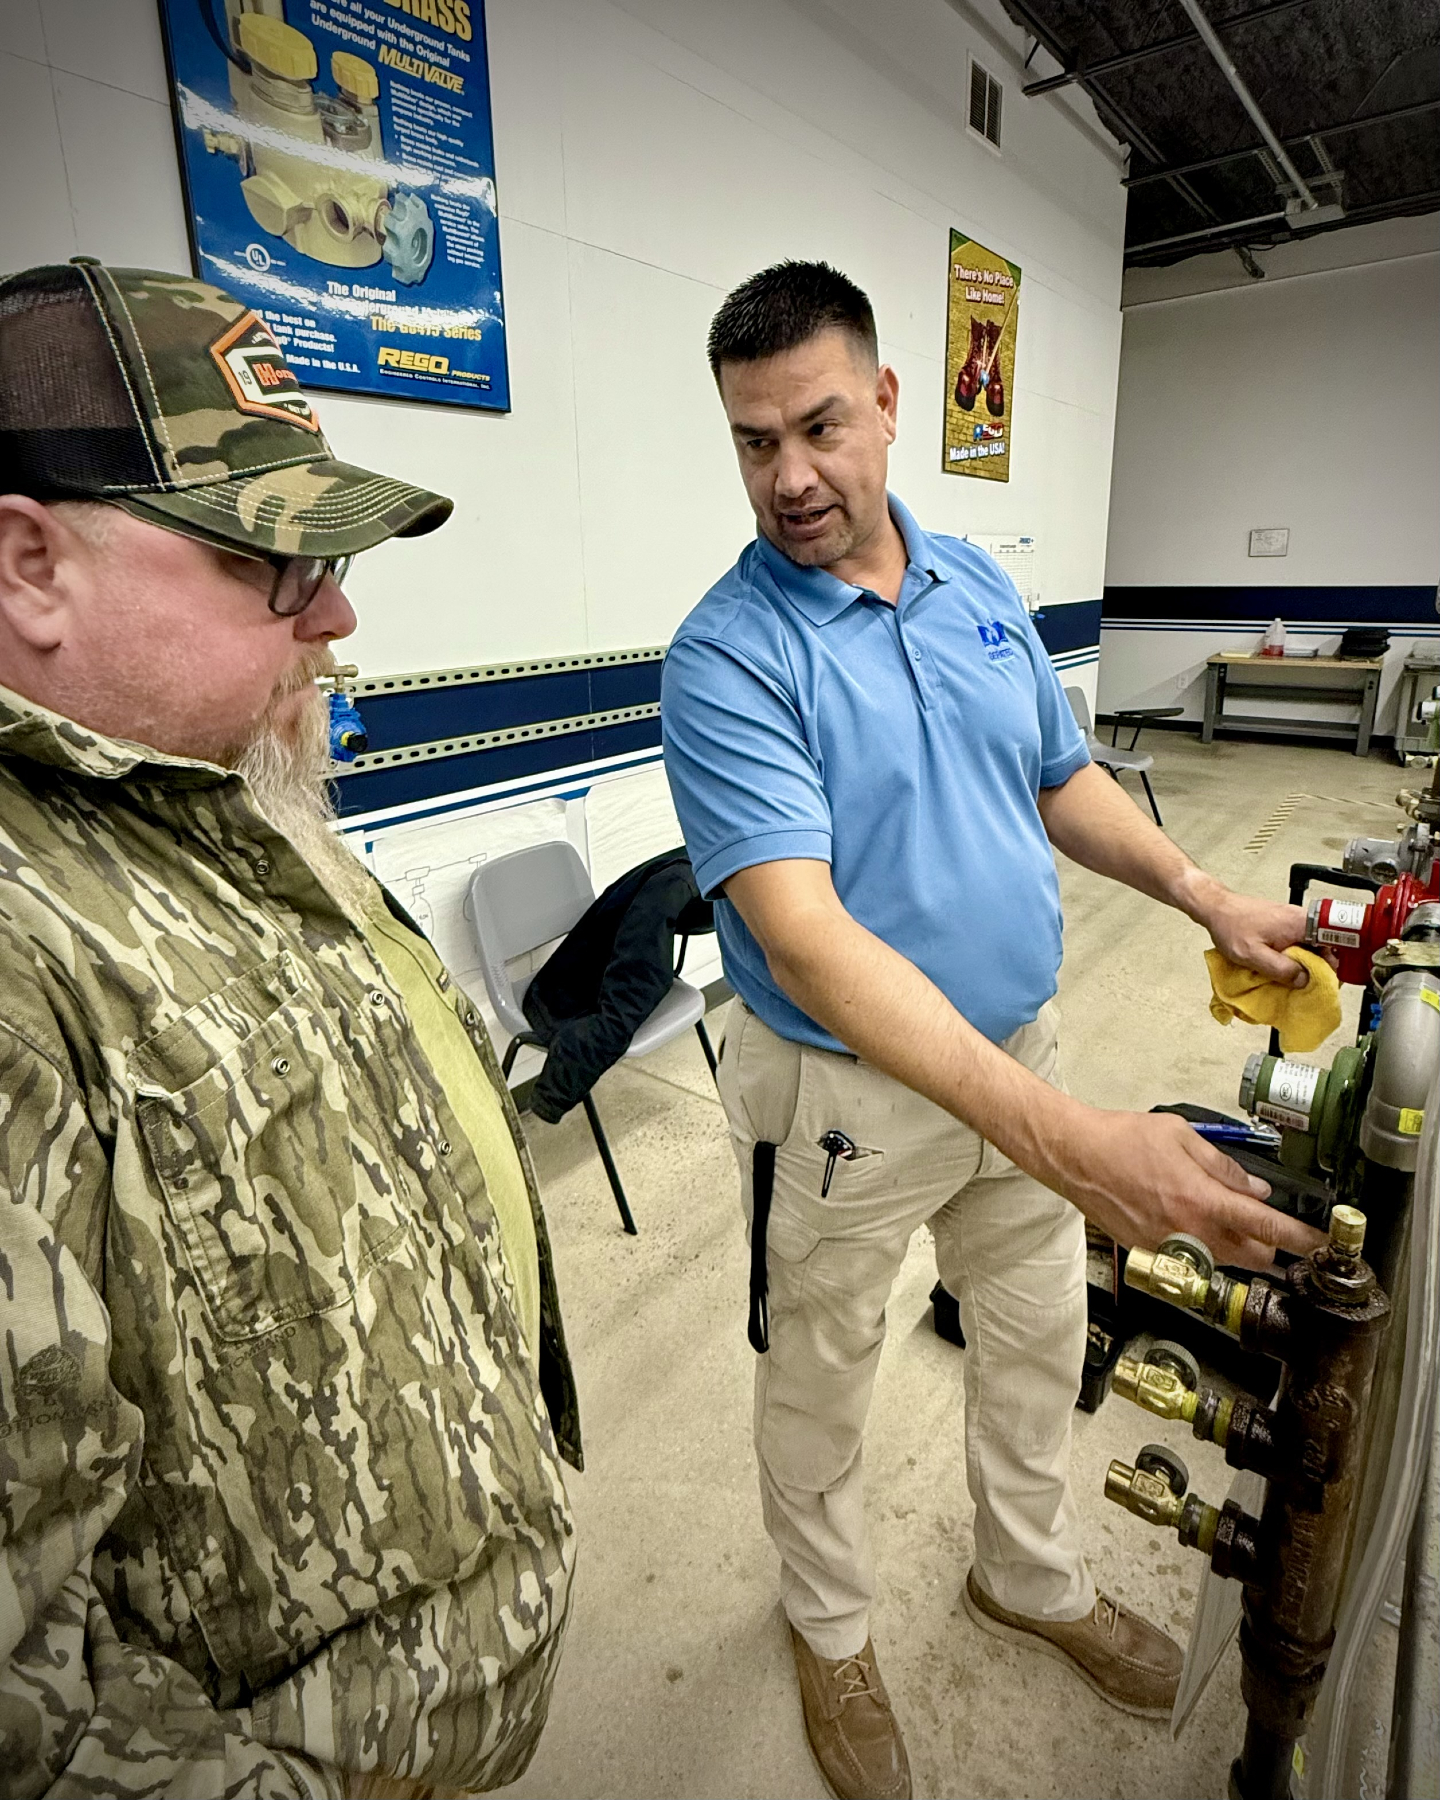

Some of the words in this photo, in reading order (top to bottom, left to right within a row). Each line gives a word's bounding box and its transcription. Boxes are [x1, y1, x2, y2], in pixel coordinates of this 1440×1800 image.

[311, 12, 376, 50] Underground
[383, 0, 472, 41] ASS
[309, 0, 327, 13] are
[329, 8, 375, 35] equipped
[377, 28, 397, 45] with
[399, 37, 414, 52] the
[416, 44, 450, 67] Original
[350, 2, 362, 14] all
[364, 8, 386, 24] your
[387, 16, 445, 51] Underground
[447, 42, 471, 62] Tanks
[954, 263, 983, 281] There's
[984, 269, 994, 284] No
[995, 271, 1014, 287] Place
[327, 281, 349, 296] The
[352, 284, 396, 302] Original
[966, 286, 981, 301] Like
[983, 289, 1005, 304] Home!
[265, 310, 281, 322] the
[282, 313, 303, 326] best
[304, 318, 316, 328] on
[371, 315, 396, 332] The
[444, 324, 482, 341] Series
[272, 323, 293, 335] tank
[294, 327, 337, 342] purchase.
[293, 337, 335, 353] Products!
[285, 353, 310, 366] Made
[311, 357, 321, 368] in
[322, 360, 337, 370] the
[337, 361, 361, 373] U.S.A.
[377, 346, 449, 375] REGO
[451, 370, 491, 382] PRODUCTS
[238, 370, 252, 385] 19
[950, 447, 969, 461] Made
[970, 445, 977, 458] in
[977, 444, 988, 457] the
[990, 442, 1005, 455] USA!
